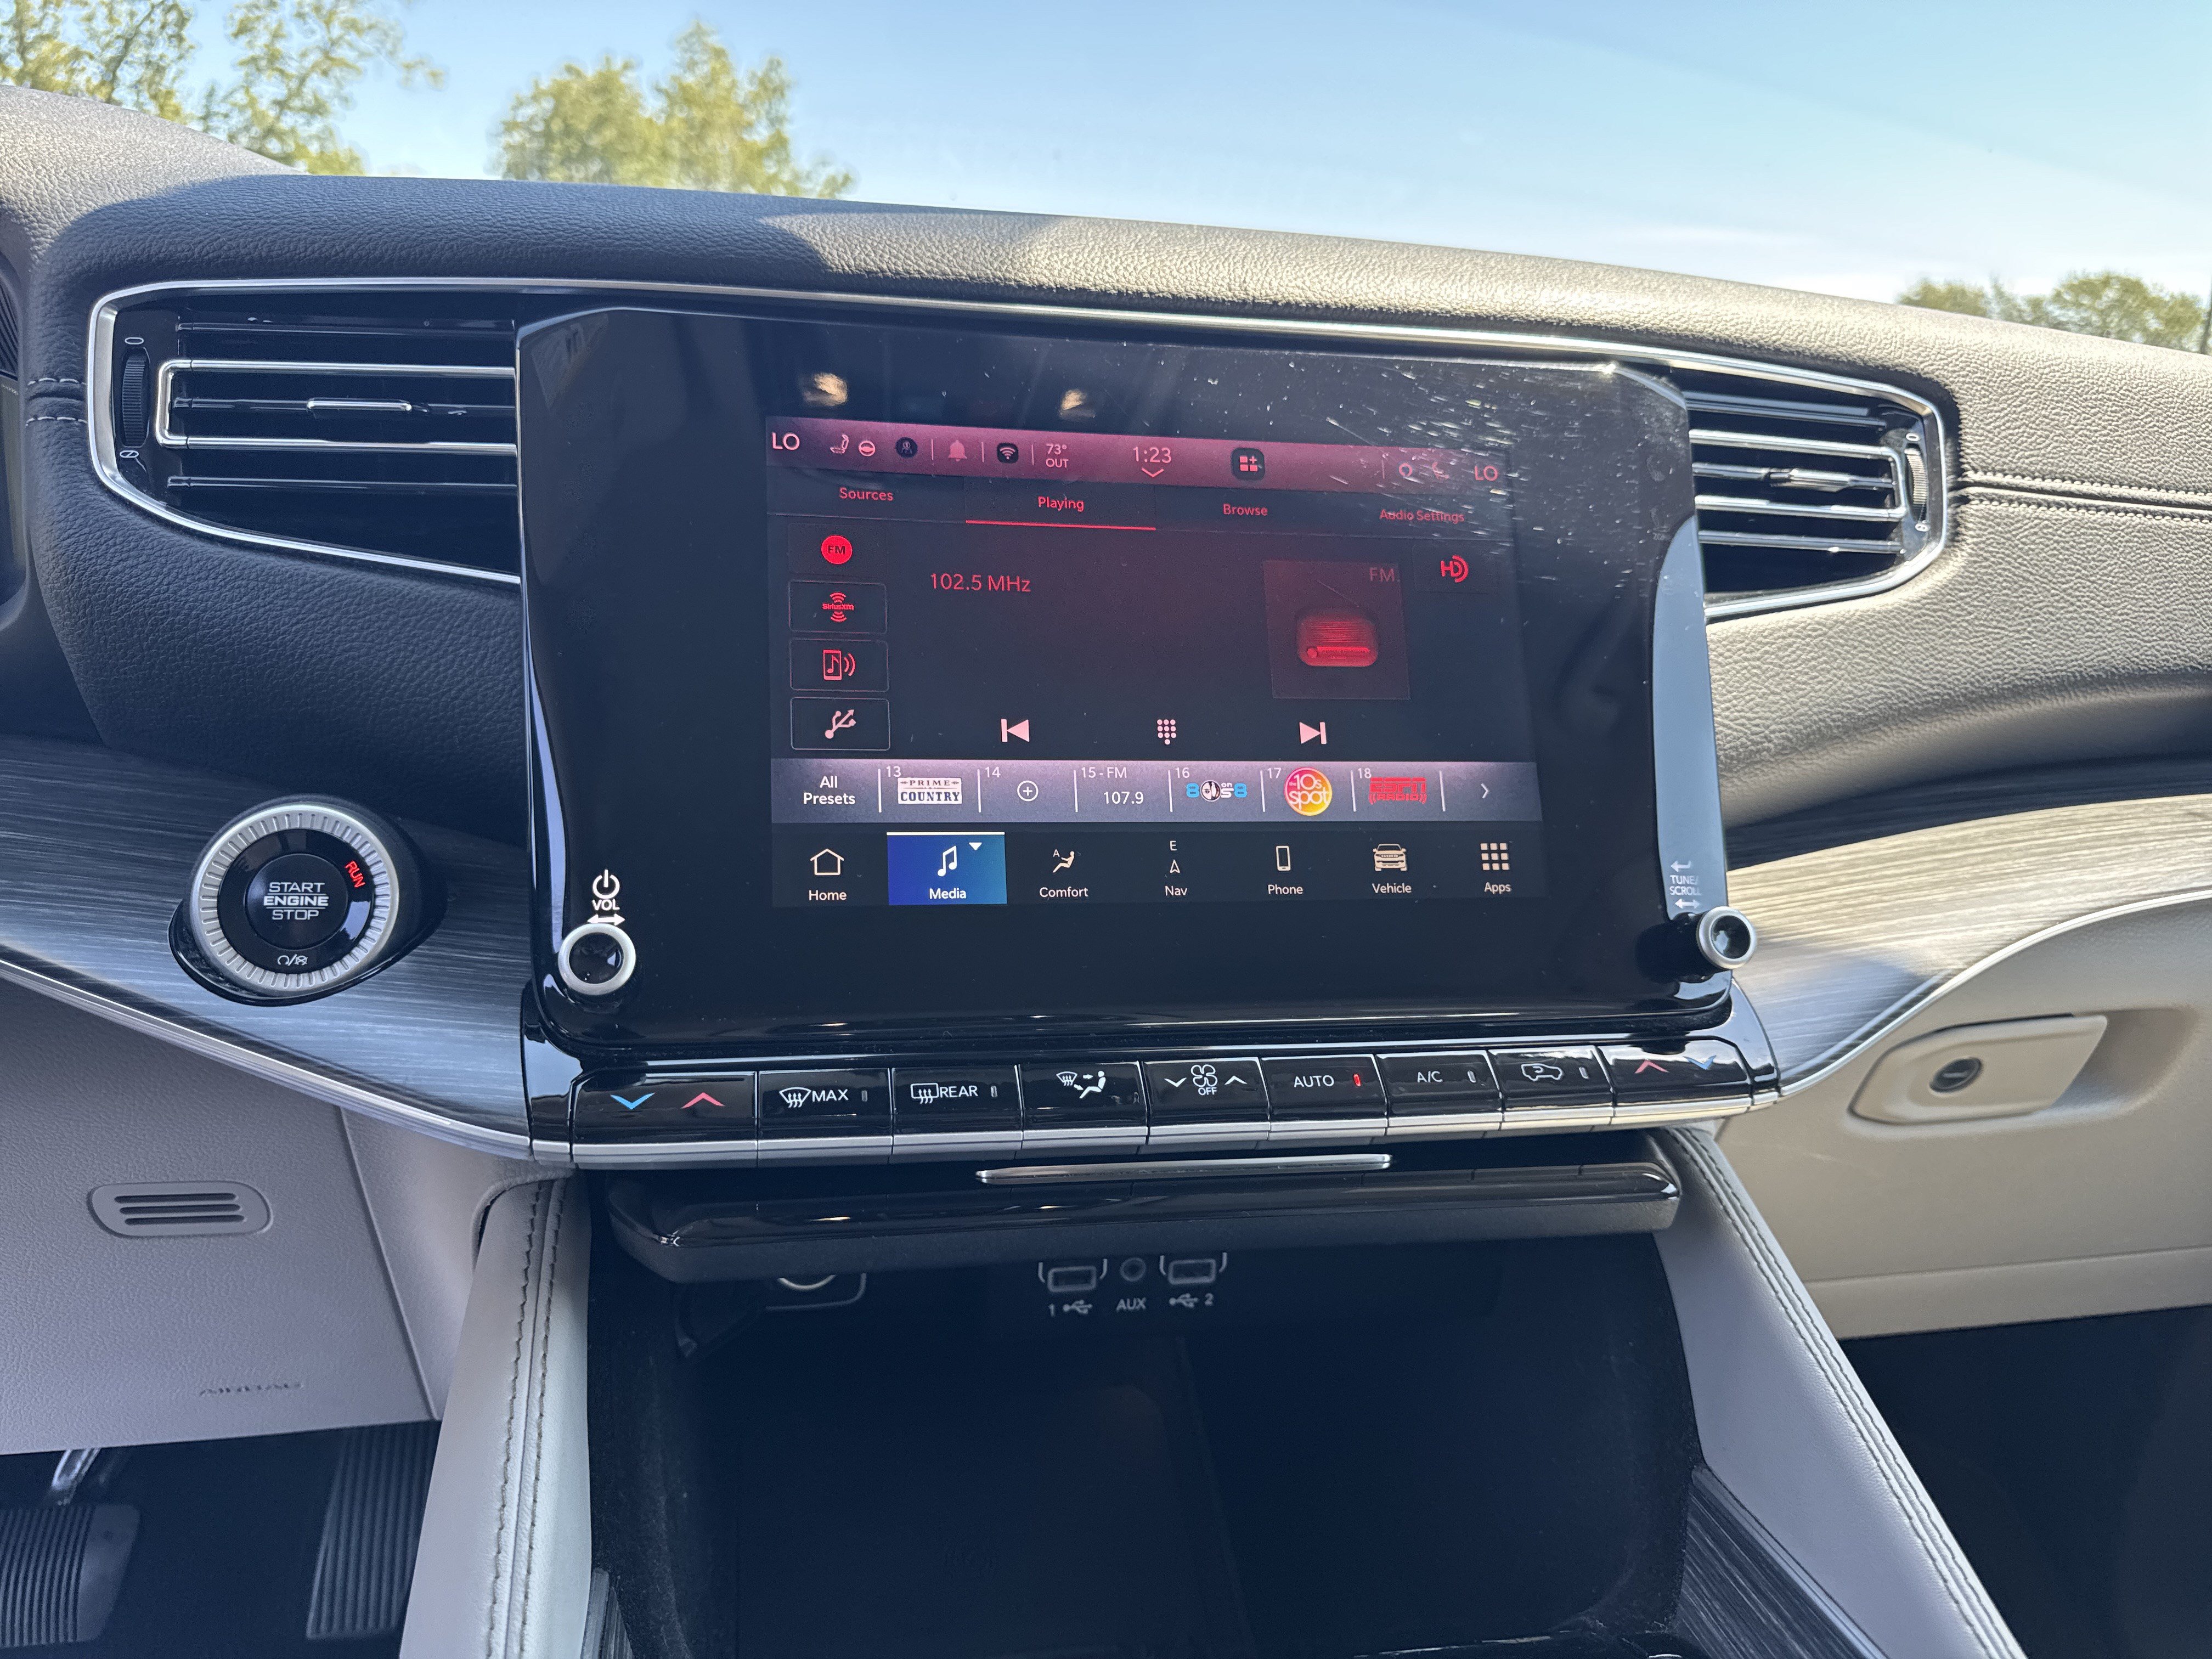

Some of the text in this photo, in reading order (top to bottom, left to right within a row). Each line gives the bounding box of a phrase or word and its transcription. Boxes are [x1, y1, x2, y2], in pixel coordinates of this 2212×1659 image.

[771, 432, 800, 451] LO
[1046, 443, 1067, 455] 73°
[1132, 445, 1172, 464] 1:23
[1045, 457, 1069, 469] OUT
[1474, 465, 1499, 481] LO
[839, 487, 894, 501] Sources
[1037, 496, 1085, 512] Playing
[1222, 503, 1268, 517] Browse
[1379, 509, 1465, 524] Audio Settings
[827, 544, 847, 555] FM
[1369, 567, 1396, 583] FM
[930, 573, 1031, 592] 102.5 MHz
[885, 765, 902, 778] 13
[985, 766, 1001, 778] 14
[1081, 766, 1096, 778] 15
[1106, 766, 1127, 779] FM
[1175, 767, 1190, 779] 16
[1267, 767, 1282, 779] 17
[1357, 768, 1372, 779] 18
[819, 775, 838, 789] All
[909, 778, 951, 788] PRIME
[1293, 774, 1322, 791] 10s
[1369, 776, 1426, 793] ESPN
[803, 792, 856, 806] Presets
[900, 789, 961, 803] COUNTRY
[1103, 791, 1144, 805] 107.9
[1289, 790, 1330, 810] spot
[1376, 793, 1419, 802] RADIO
[1170, 840, 1178, 851] E
[345, 860, 366, 889] RUN
[268, 881, 326, 894] START
[928, 888, 967, 900] Media
[1039, 885, 1089, 898] Comfort
[1165, 885, 1188, 897] Nav
[1267, 884, 1304, 896] Phone
[1372, 882, 1412, 894] Vehicle
[1484, 882, 1511, 895] Apps
[1669, 885, 1702, 896] SCROLL
[263, 895, 329, 907] ENGINE
[808, 889, 847, 901] Home
[591, 899, 620, 911] VOL
[272, 910, 320, 921] STOP
[1293, 1074, 1335, 1088] AUTO
[1417, 1070, 1444, 1084] A/C
[811, 1088, 849, 1103] MAX
[939, 1085, 979, 1099] REAR
[1198, 1086, 1217, 1096] OFF
[1115, 1297, 1147, 1312] AUX
[1204, 1293, 1214, 1306] 2
[1048, 1303, 1056, 1317] 1
